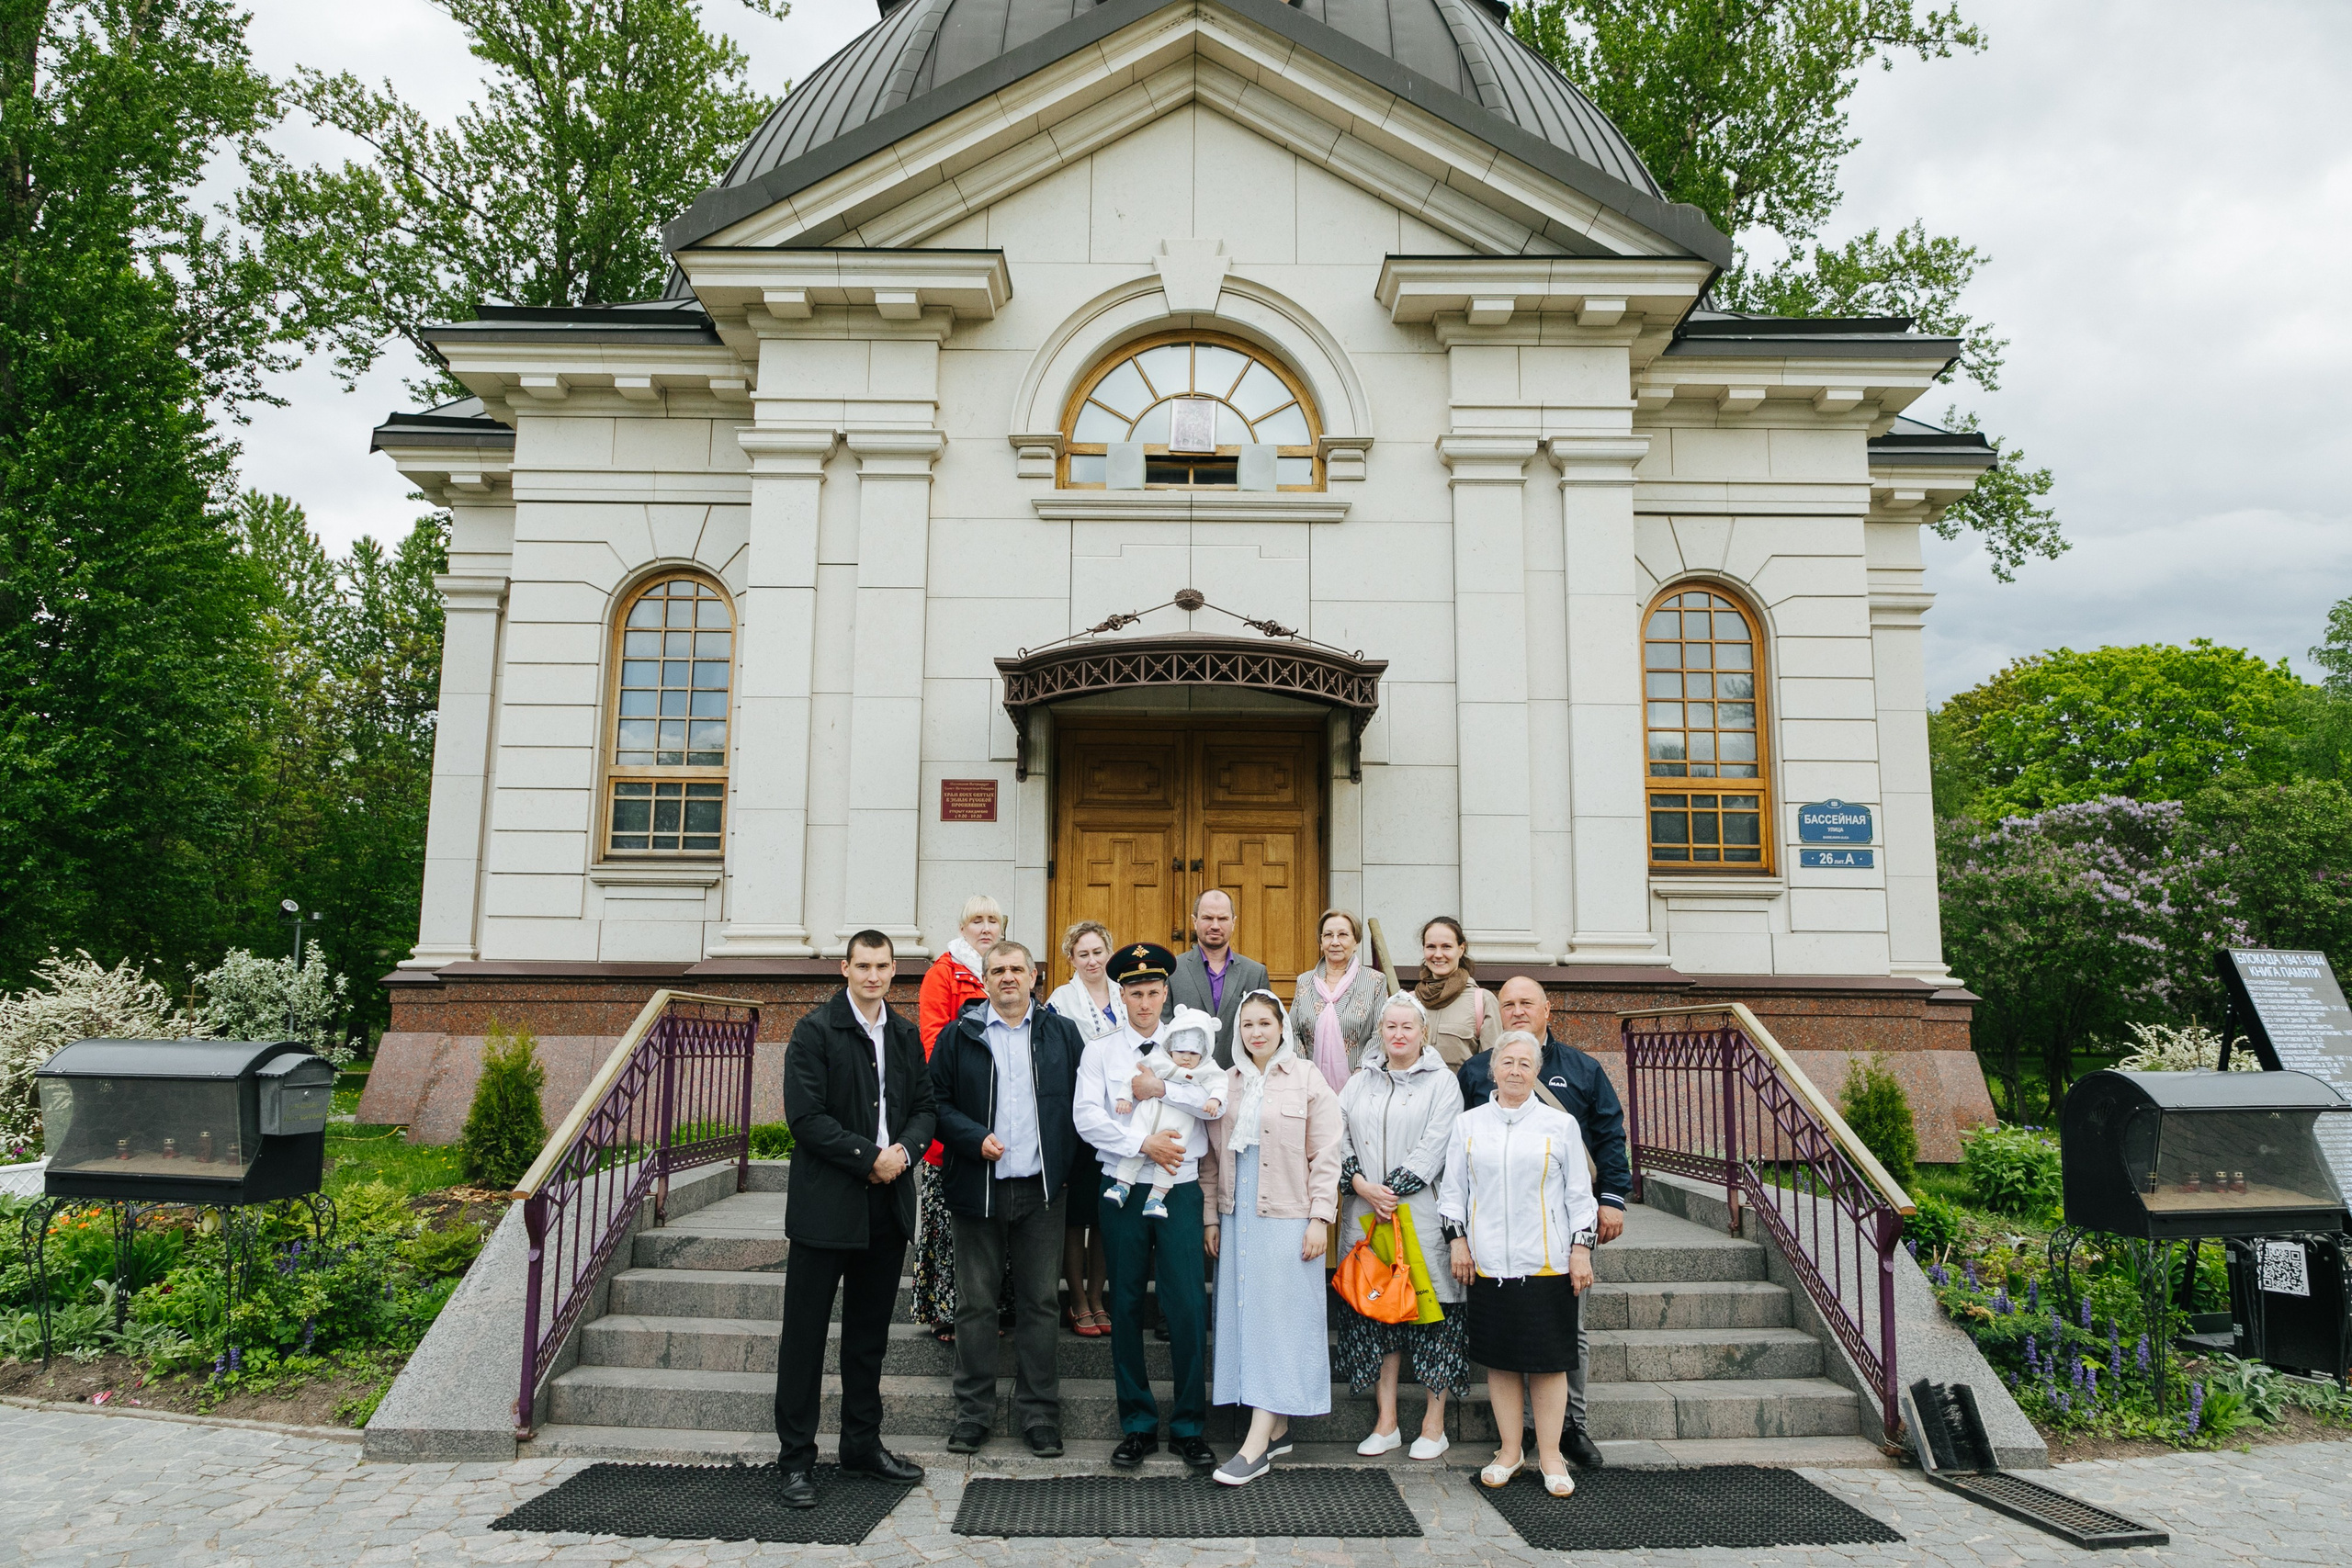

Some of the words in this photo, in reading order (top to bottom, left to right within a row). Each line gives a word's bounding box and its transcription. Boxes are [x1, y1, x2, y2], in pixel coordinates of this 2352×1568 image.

[1804, 813, 1866, 825] БАССЕЙНАЯ
[1820, 853, 1833, 864] 26
[2234, 953, 2281, 965] БЛОКАДА
[2281, 955, 2325, 966] 1941-1944
[2248, 966, 2281, 977] КНИГА
[2280, 967, 2322, 978] ПАМЯТИ
